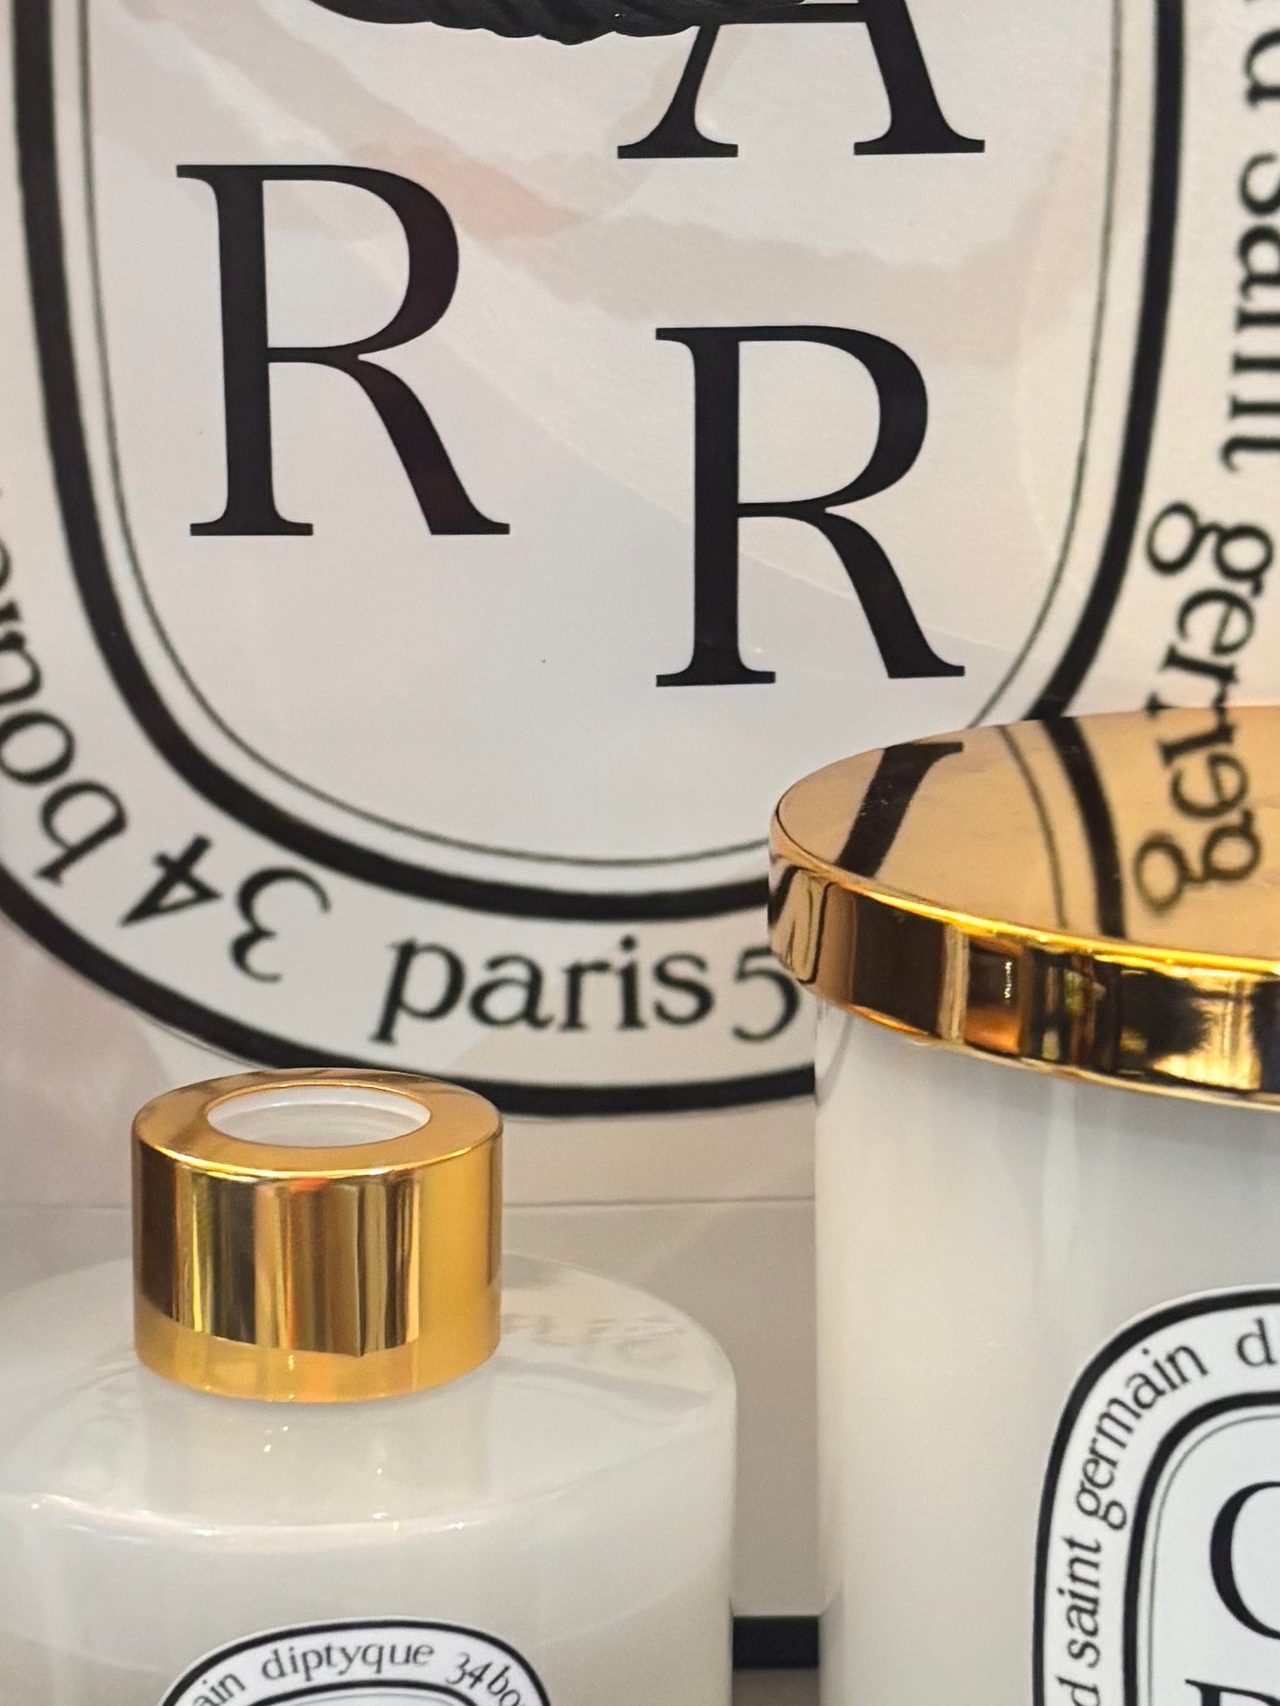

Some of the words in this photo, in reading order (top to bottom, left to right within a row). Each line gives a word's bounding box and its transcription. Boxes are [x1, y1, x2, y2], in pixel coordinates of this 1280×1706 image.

[1075, 1341, 1210, 1530] germain
[262, 1641, 435, 1680] diptyque
[1054, 1536, 1102, 1670] saint
